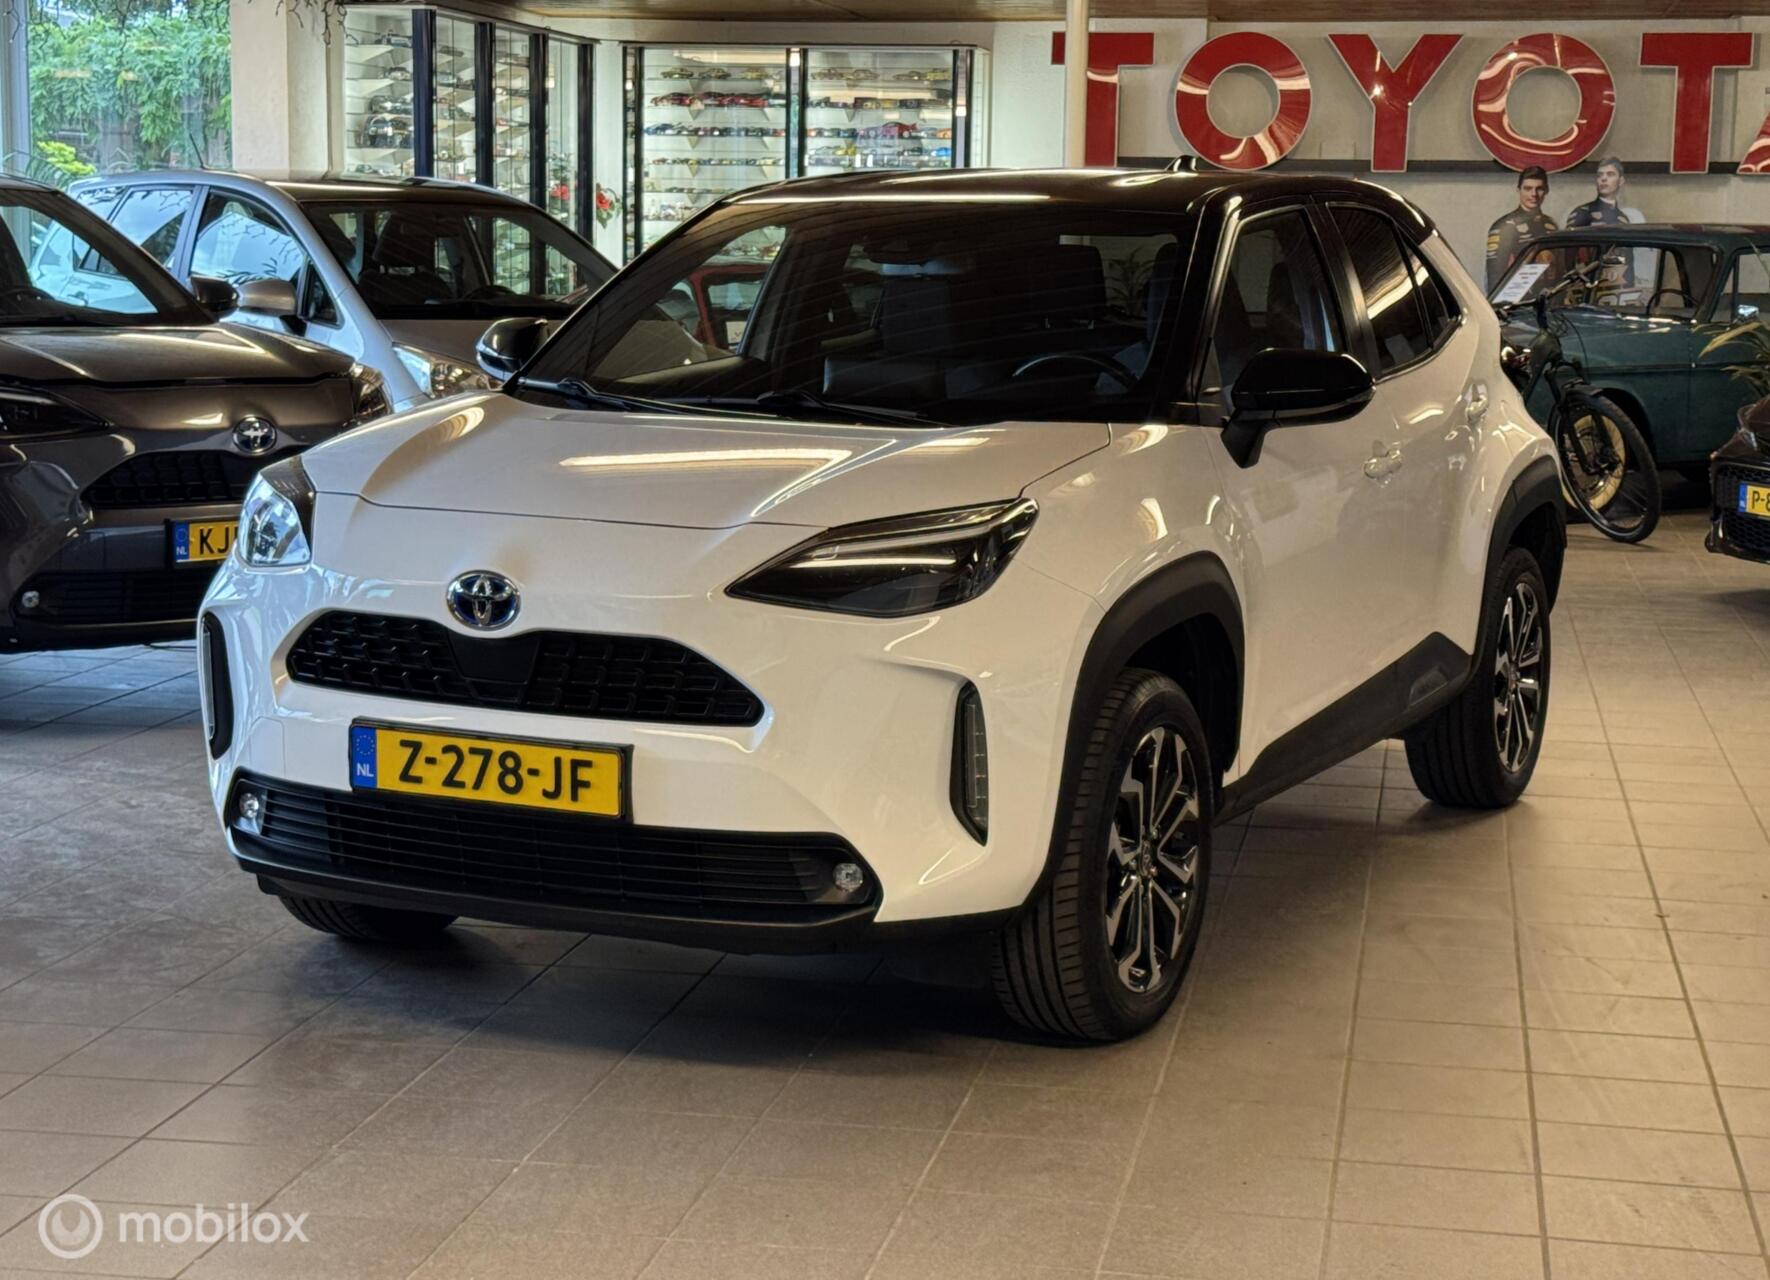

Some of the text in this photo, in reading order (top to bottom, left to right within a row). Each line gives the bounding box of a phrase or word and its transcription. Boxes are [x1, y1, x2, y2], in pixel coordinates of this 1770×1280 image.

[1051, 31, 1770, 174] TOYOT
[176, 526, 239, 555] NL KJ
[356, 739, 593, 802] NL Z-278-JF
